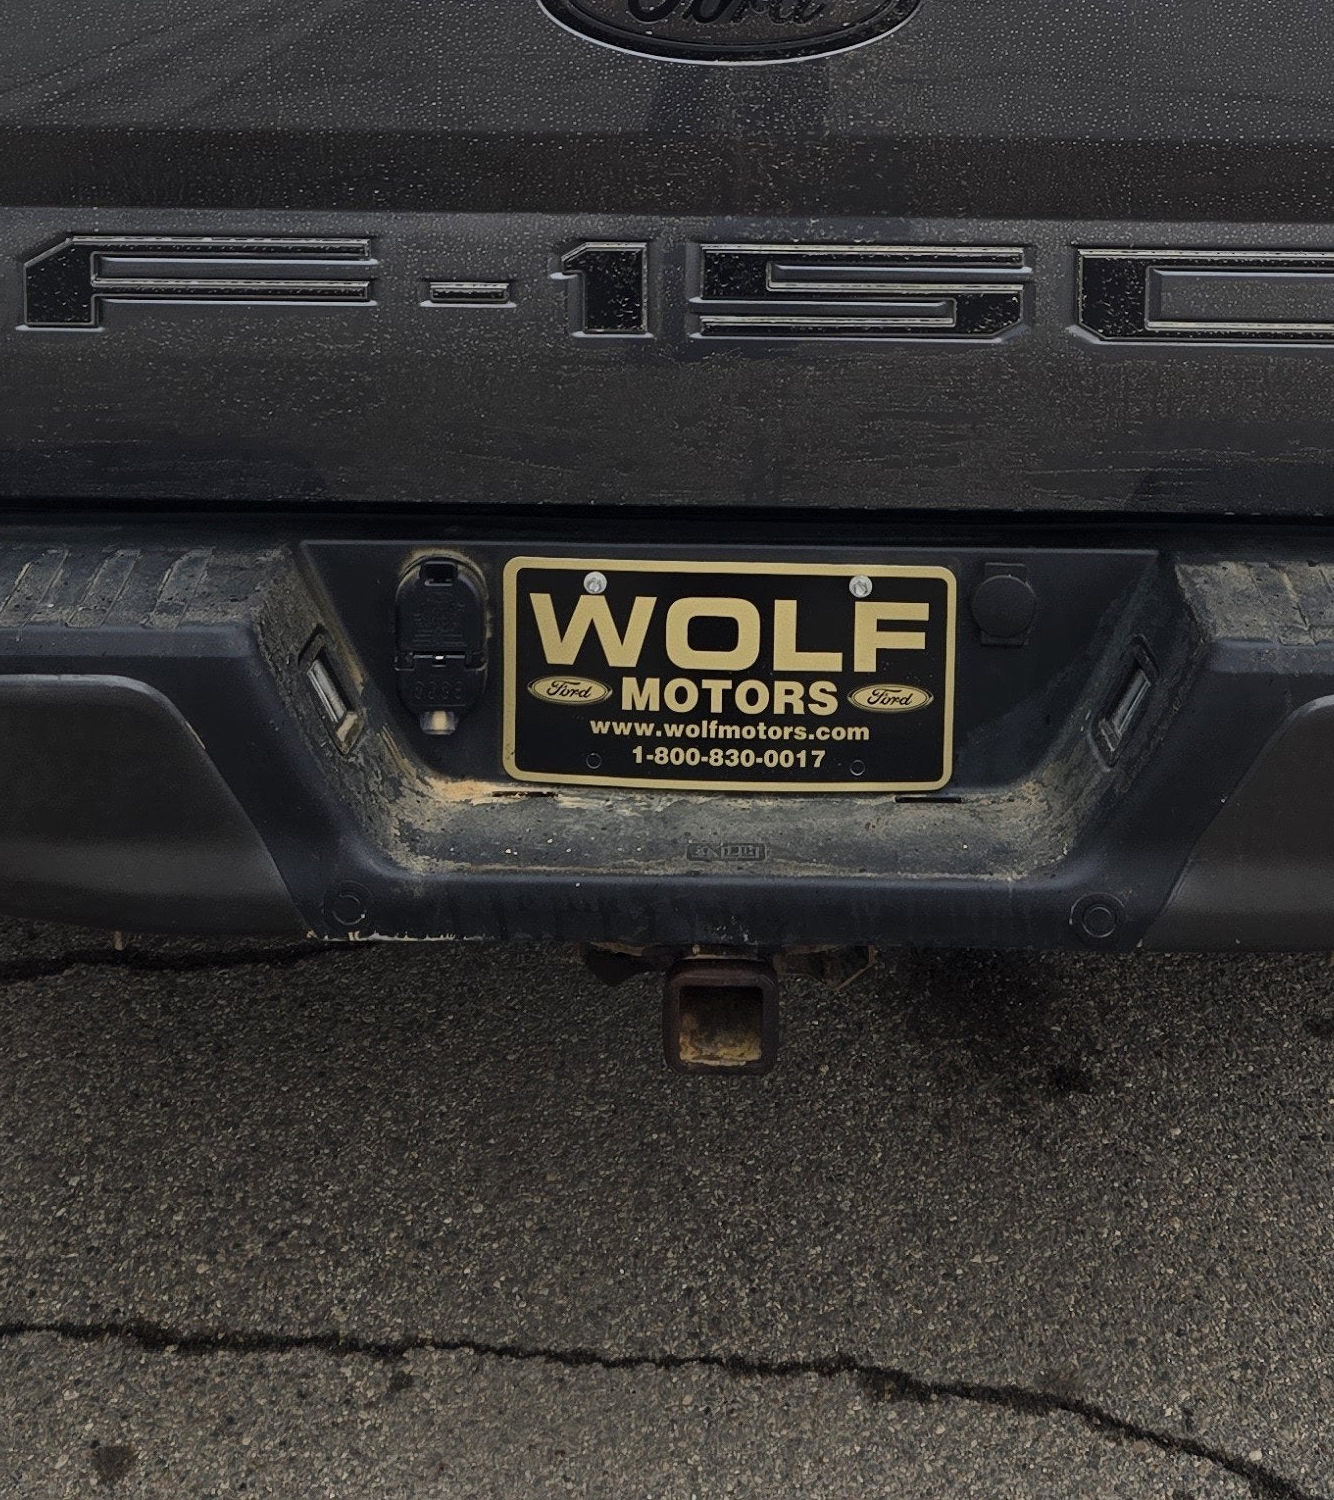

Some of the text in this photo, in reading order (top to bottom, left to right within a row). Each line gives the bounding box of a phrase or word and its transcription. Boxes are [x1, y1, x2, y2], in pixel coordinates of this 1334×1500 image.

[529, 592, 930, 673] WOLF
[546, 680, 593, 699] Ford
[621, 677, 839, 716] MOTORS
[867, 688, 913, 706] Ford
[590, 719, 870, 741] www.wolfmotors.com
[632, 745, 826, 769] 1-800-830-0017
